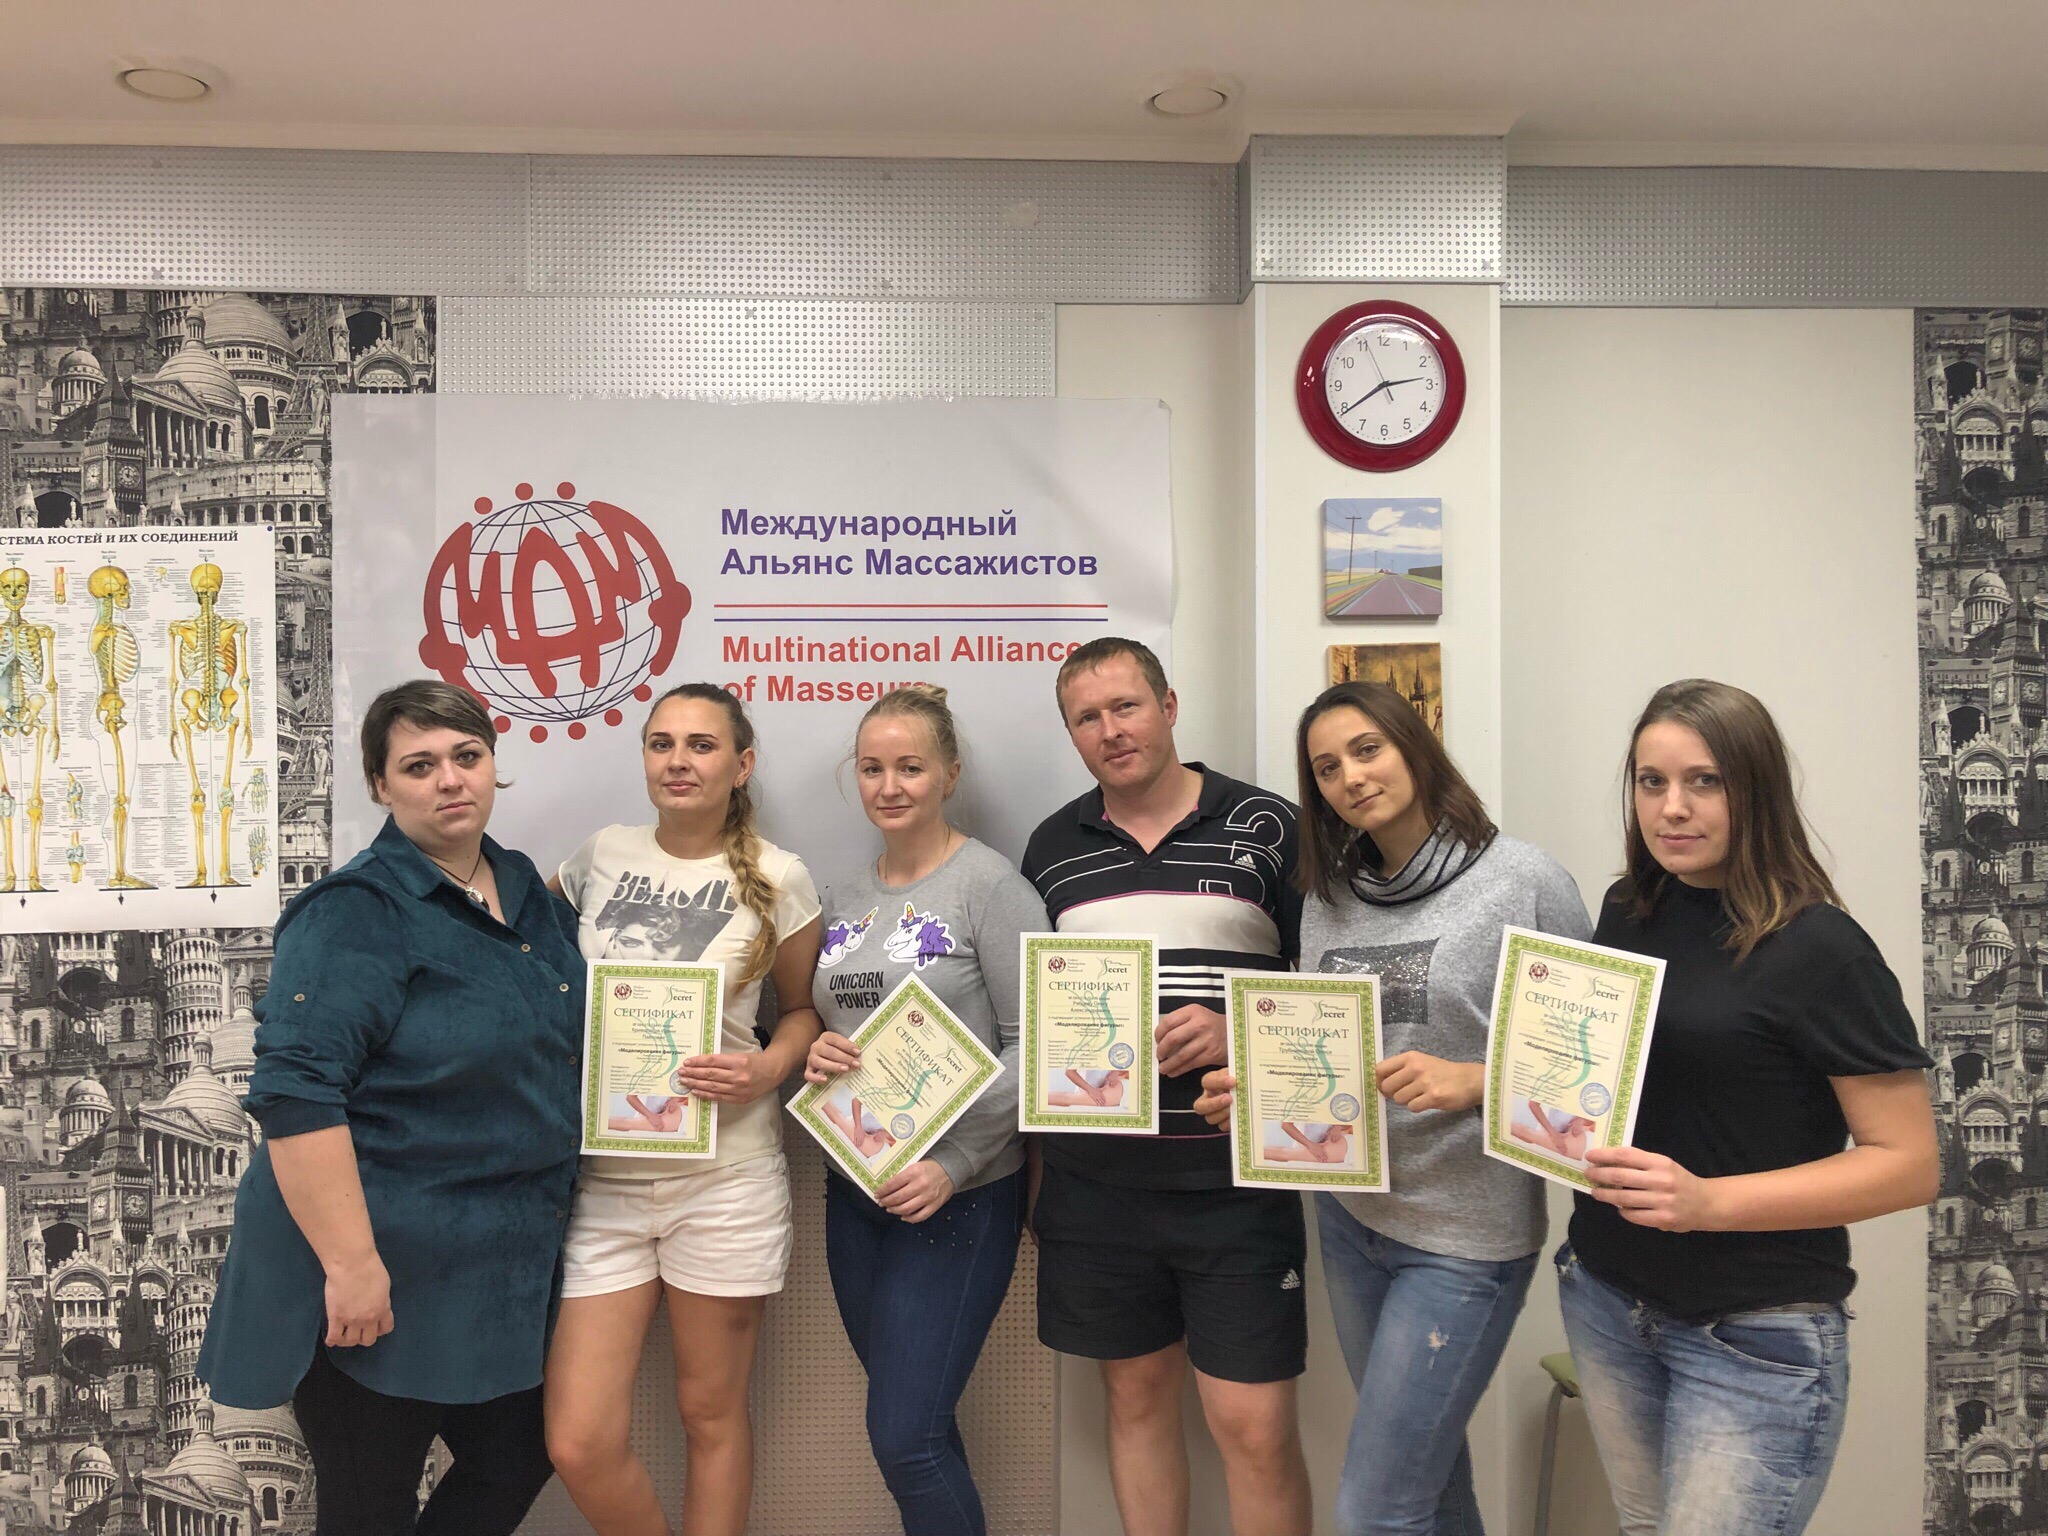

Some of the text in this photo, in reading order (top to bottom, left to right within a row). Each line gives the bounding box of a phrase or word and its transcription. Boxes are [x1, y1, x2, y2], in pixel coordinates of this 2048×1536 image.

[1357, 340, 1369, 352] 11
[1377, 335, 1390, 347] 12
[1403, 341, 1409, 351] 1
[1341, 356, 1355, 369] 10
[1419, 356, 1427, 367] 2
[1334, 380, 1342, 391] 9
[1426, 379, 1434, 390] 3
[1341, 402, 1350, 413] 8
[1419, 401, 1428, 412] 4
[1358, 419, 1367, 431] 7
[1403, 418, 1411, 430] 5
[1380, 425, 1388, 436] 6
[721, 509, 1017, 542] Международный
[47, 532, 102, 545] КОСТЕЙ
[106, 535, 115, 544] И
[119, 534, 138, 544] ИХ
[141, 530, 239, 544] СОЕДИНЕНИЙ
[720, 549, 1098, 576] Альянс Массажистов
[723, 635, 941, 663] Multinational
[722, 675, 757, 702] of
[829, 971, 884, 991] UNICORN
[1048, 981, 1131, 991] СЕРТИФИКАТ
[835, 992, 880, 1009] POWER
[613, 1007, 694, 1019] СЕРТИФИКАТ
[1525, 990, 1619, 1024] СЕРТИФИКАТ
[1258, 1025, 1350, 1038] СЕРТИФИКАТ
[895, 1026, 955, 1086] СЕРТИФИКАТ
